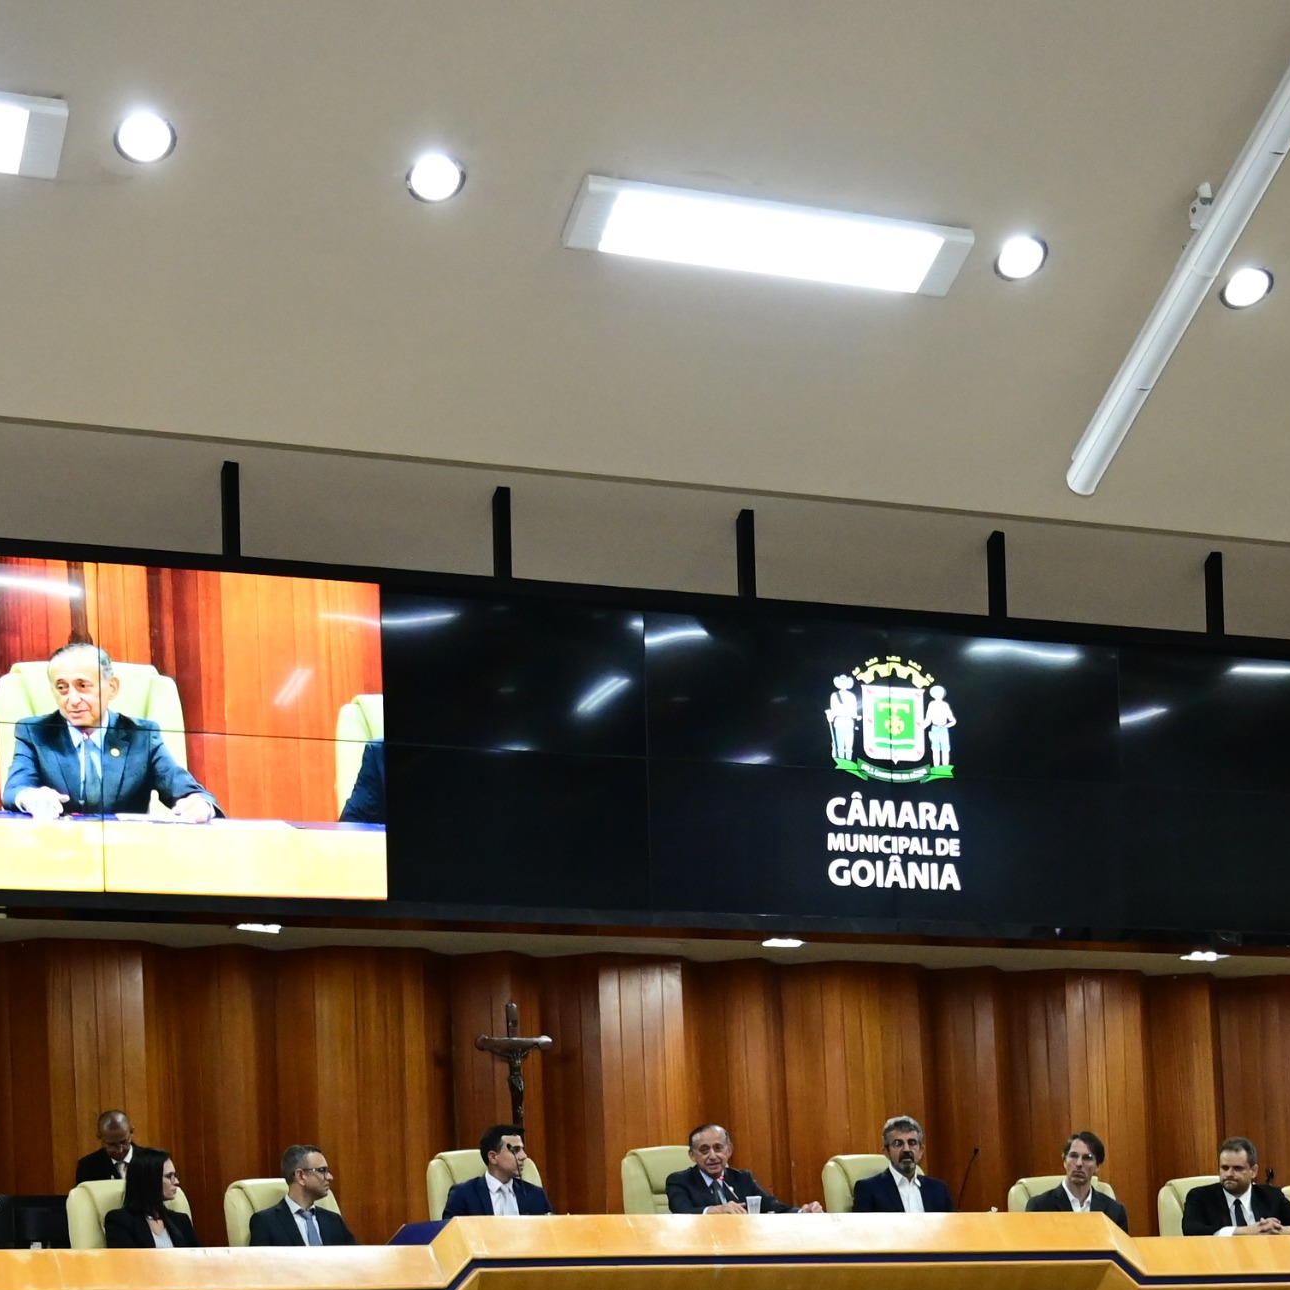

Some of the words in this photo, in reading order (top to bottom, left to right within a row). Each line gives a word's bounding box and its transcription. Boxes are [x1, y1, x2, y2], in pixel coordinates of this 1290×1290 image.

[826, 791, 959, 831] CÂMARA
[827, 832, 933, 856] MUNICIPAL
[935, 837, 961, 857] DE
[828, 855, 961, 891] GOIÂNIA
